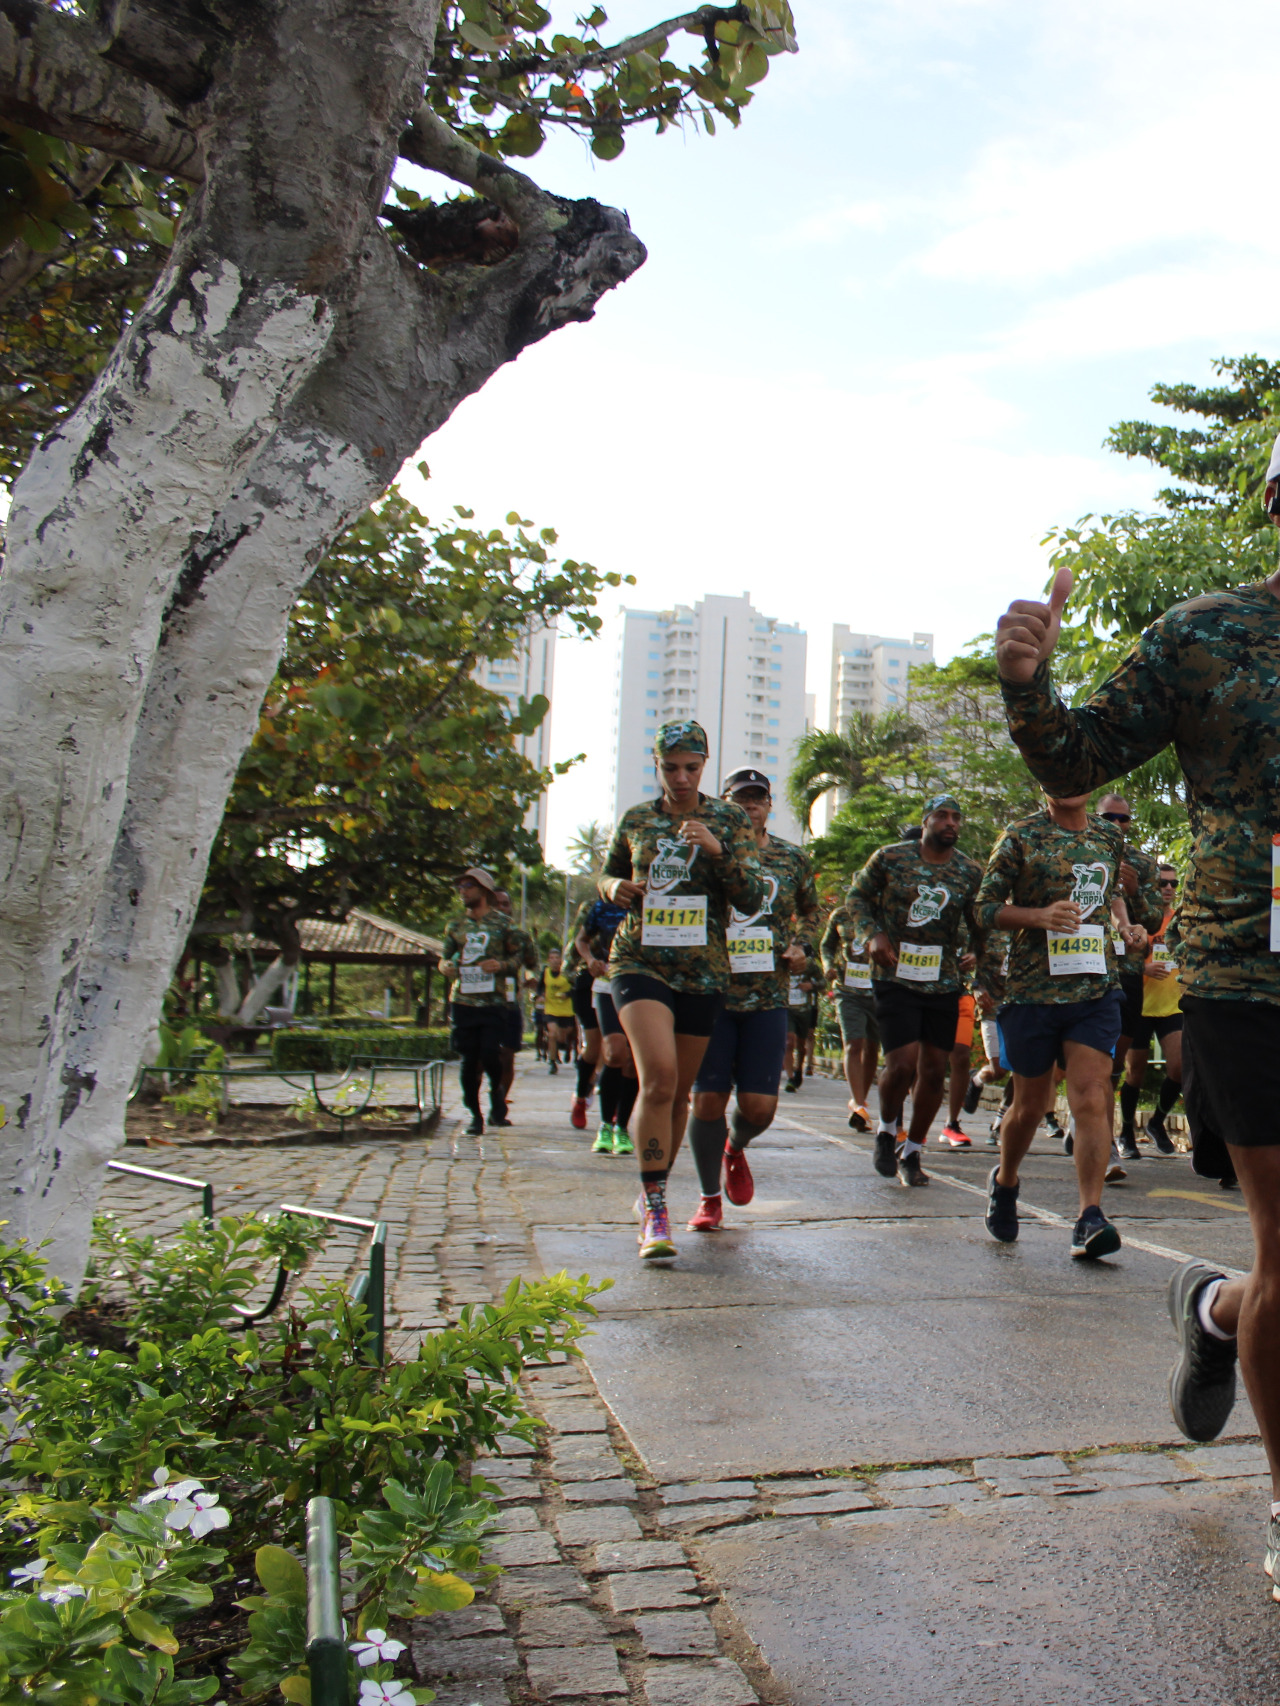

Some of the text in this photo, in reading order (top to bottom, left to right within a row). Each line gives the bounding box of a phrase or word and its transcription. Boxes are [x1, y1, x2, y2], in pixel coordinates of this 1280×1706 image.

[661, 869, 689, 879] COPPA
[646, 909, 698, 924] 14117
[1051, 938, 1099, 954] 14492
[901, 951, 933, 966] 14181
